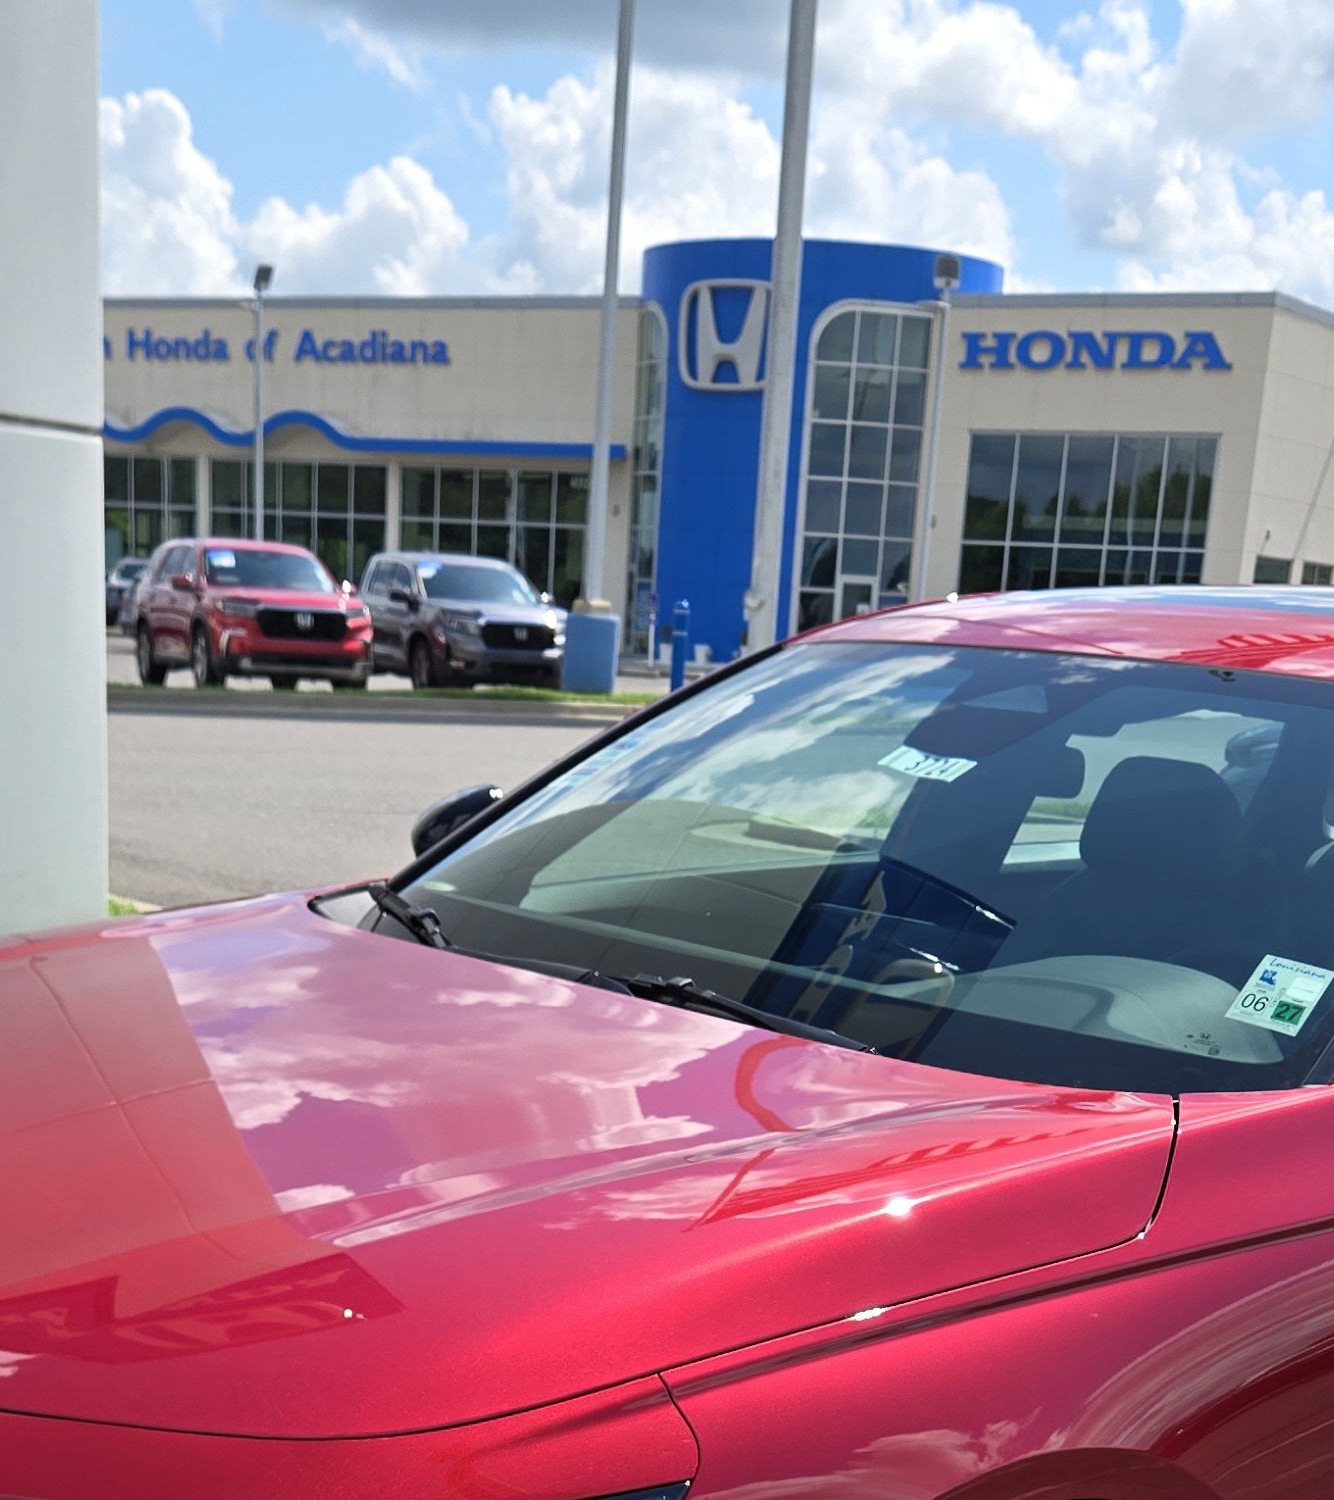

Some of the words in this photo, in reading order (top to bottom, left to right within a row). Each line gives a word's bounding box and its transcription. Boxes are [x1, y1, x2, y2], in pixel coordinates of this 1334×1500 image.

[127, 327, 229, 362] Honda
[245, 328, 278, 363] of
[294, 328, 451, 364] Acadiana
[959, 330, 1233, 371] HONDA
[1240, 992, 1270, 1013] 06
[1275, 1003, 1305, 1022] 27
